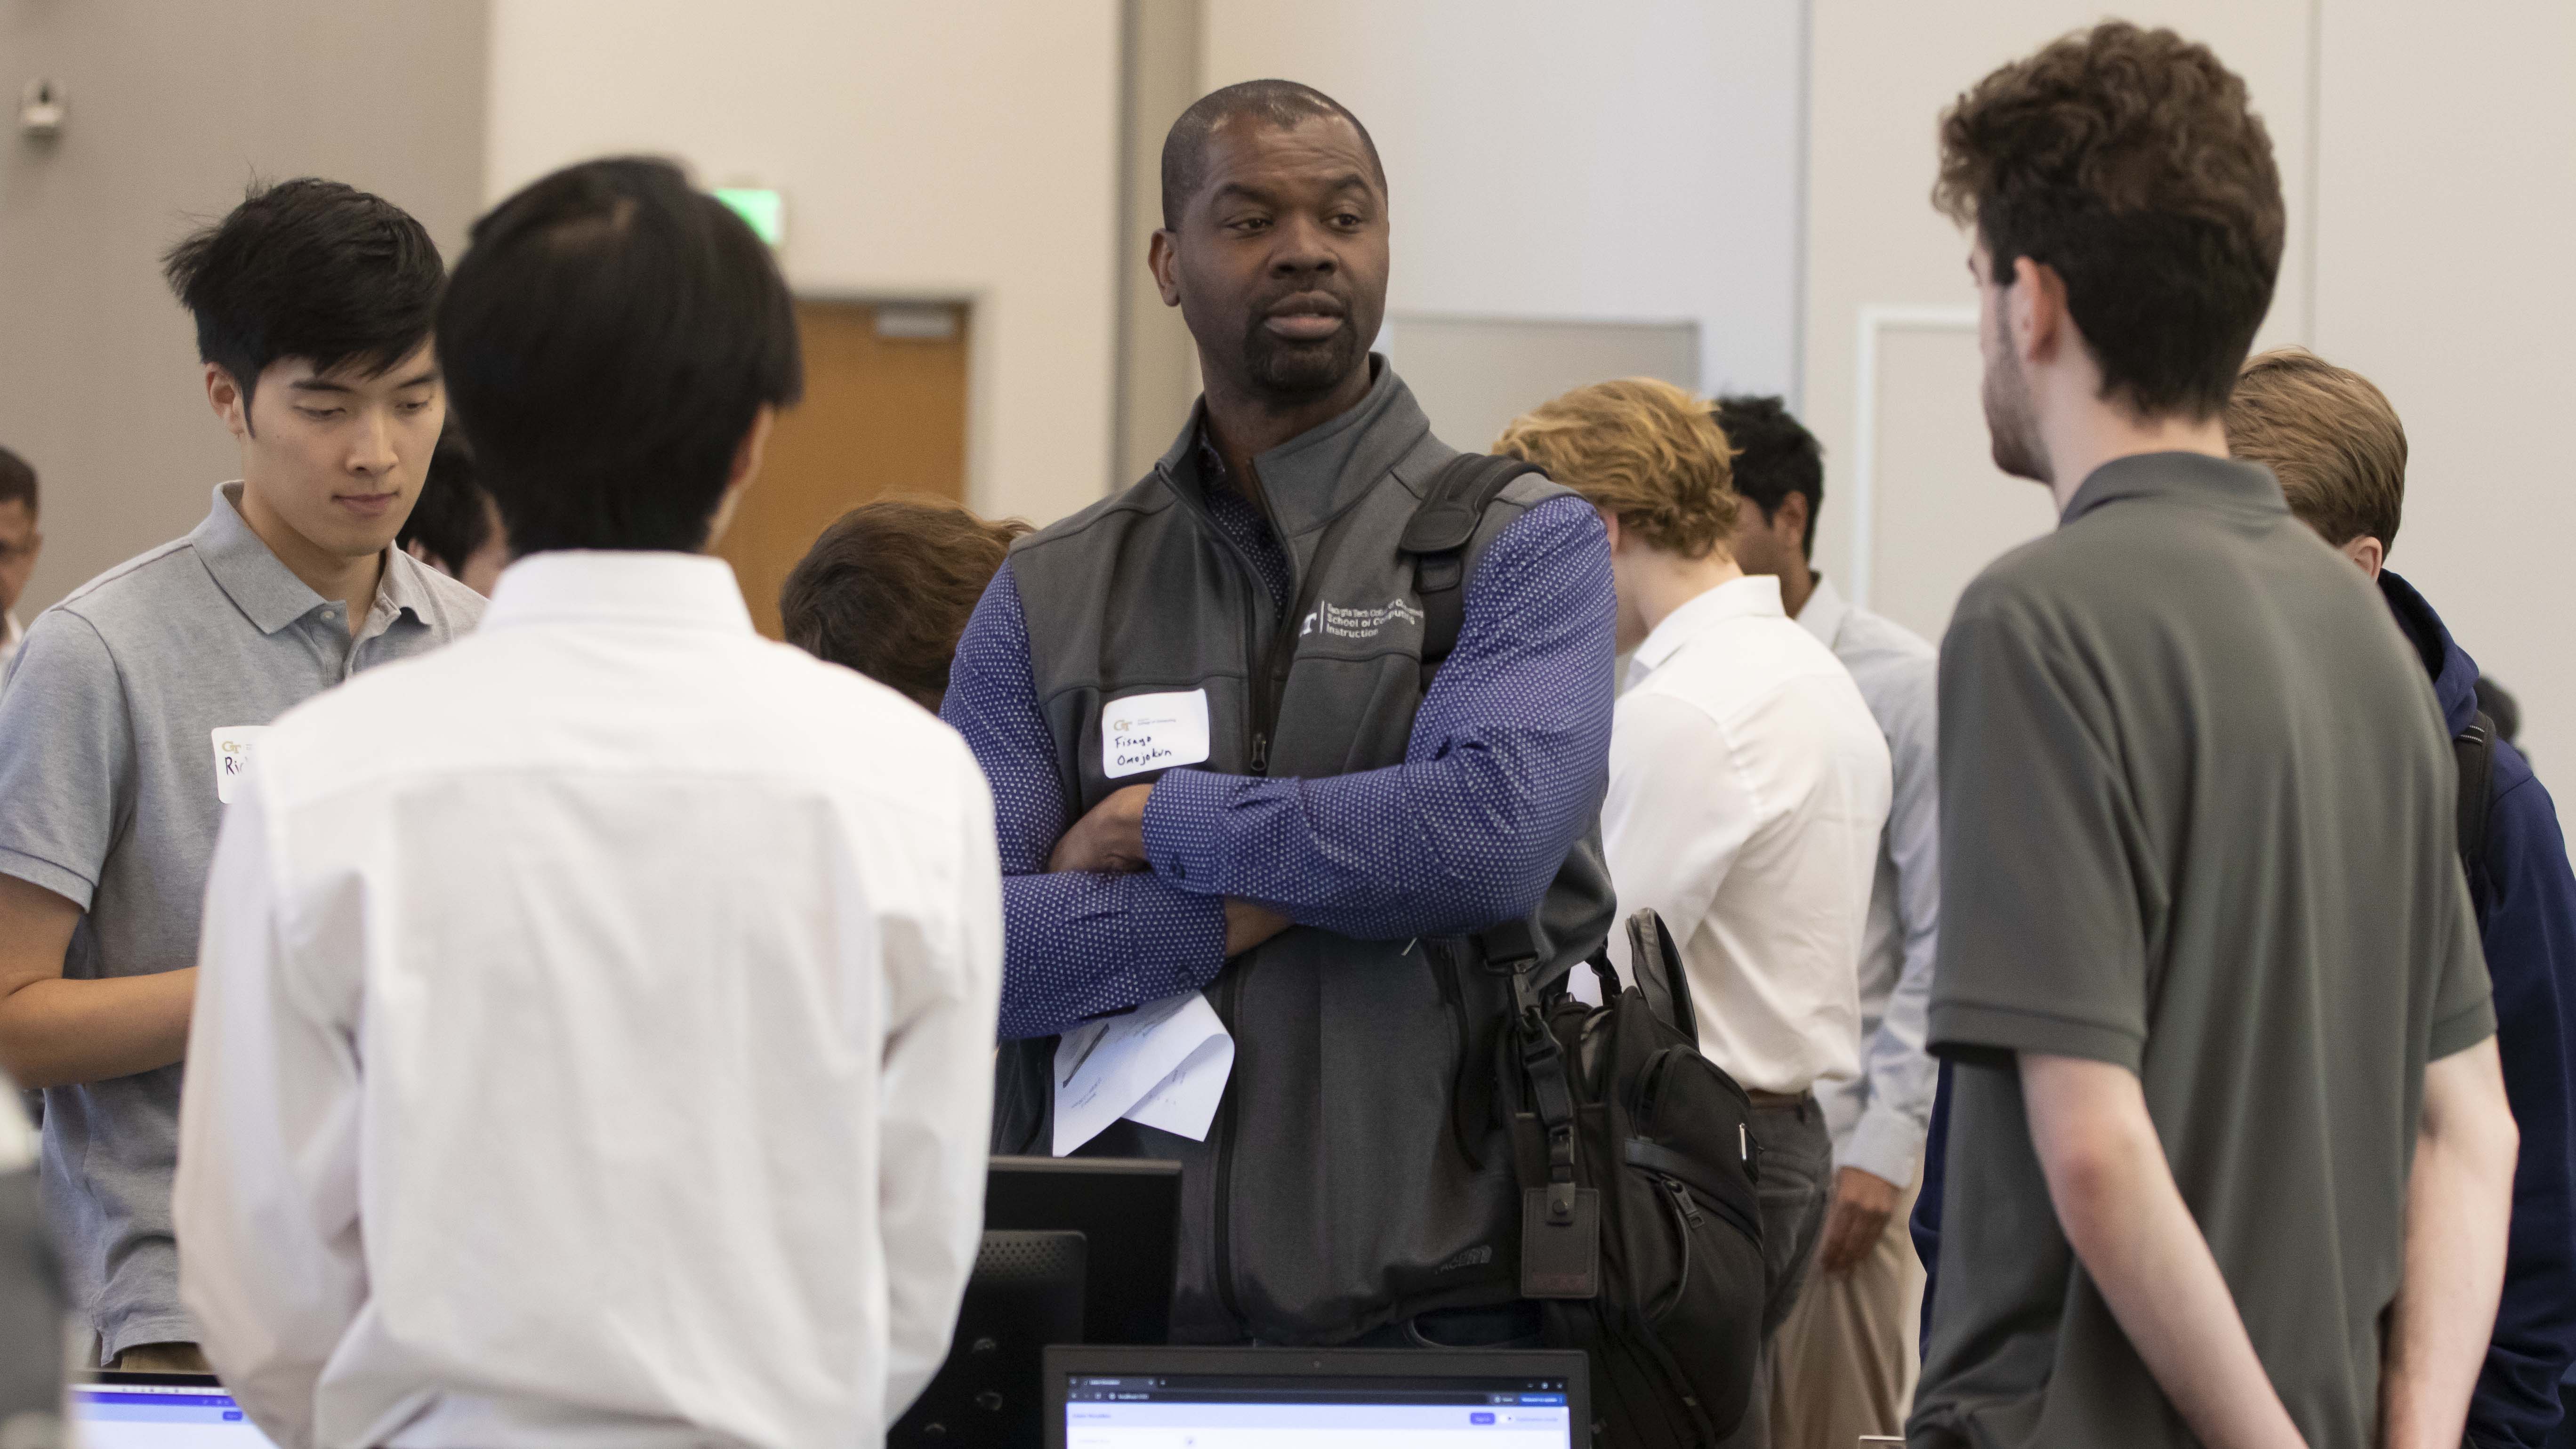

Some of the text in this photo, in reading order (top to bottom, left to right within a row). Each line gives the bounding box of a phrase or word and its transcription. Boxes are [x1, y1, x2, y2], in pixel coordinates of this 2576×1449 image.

[1328, 612, 1359, 628] School
[1361, 619, 1370, 628] of
[1327, 622, 1378, 638] Instruction
[222, 741, 241, 754] GT
